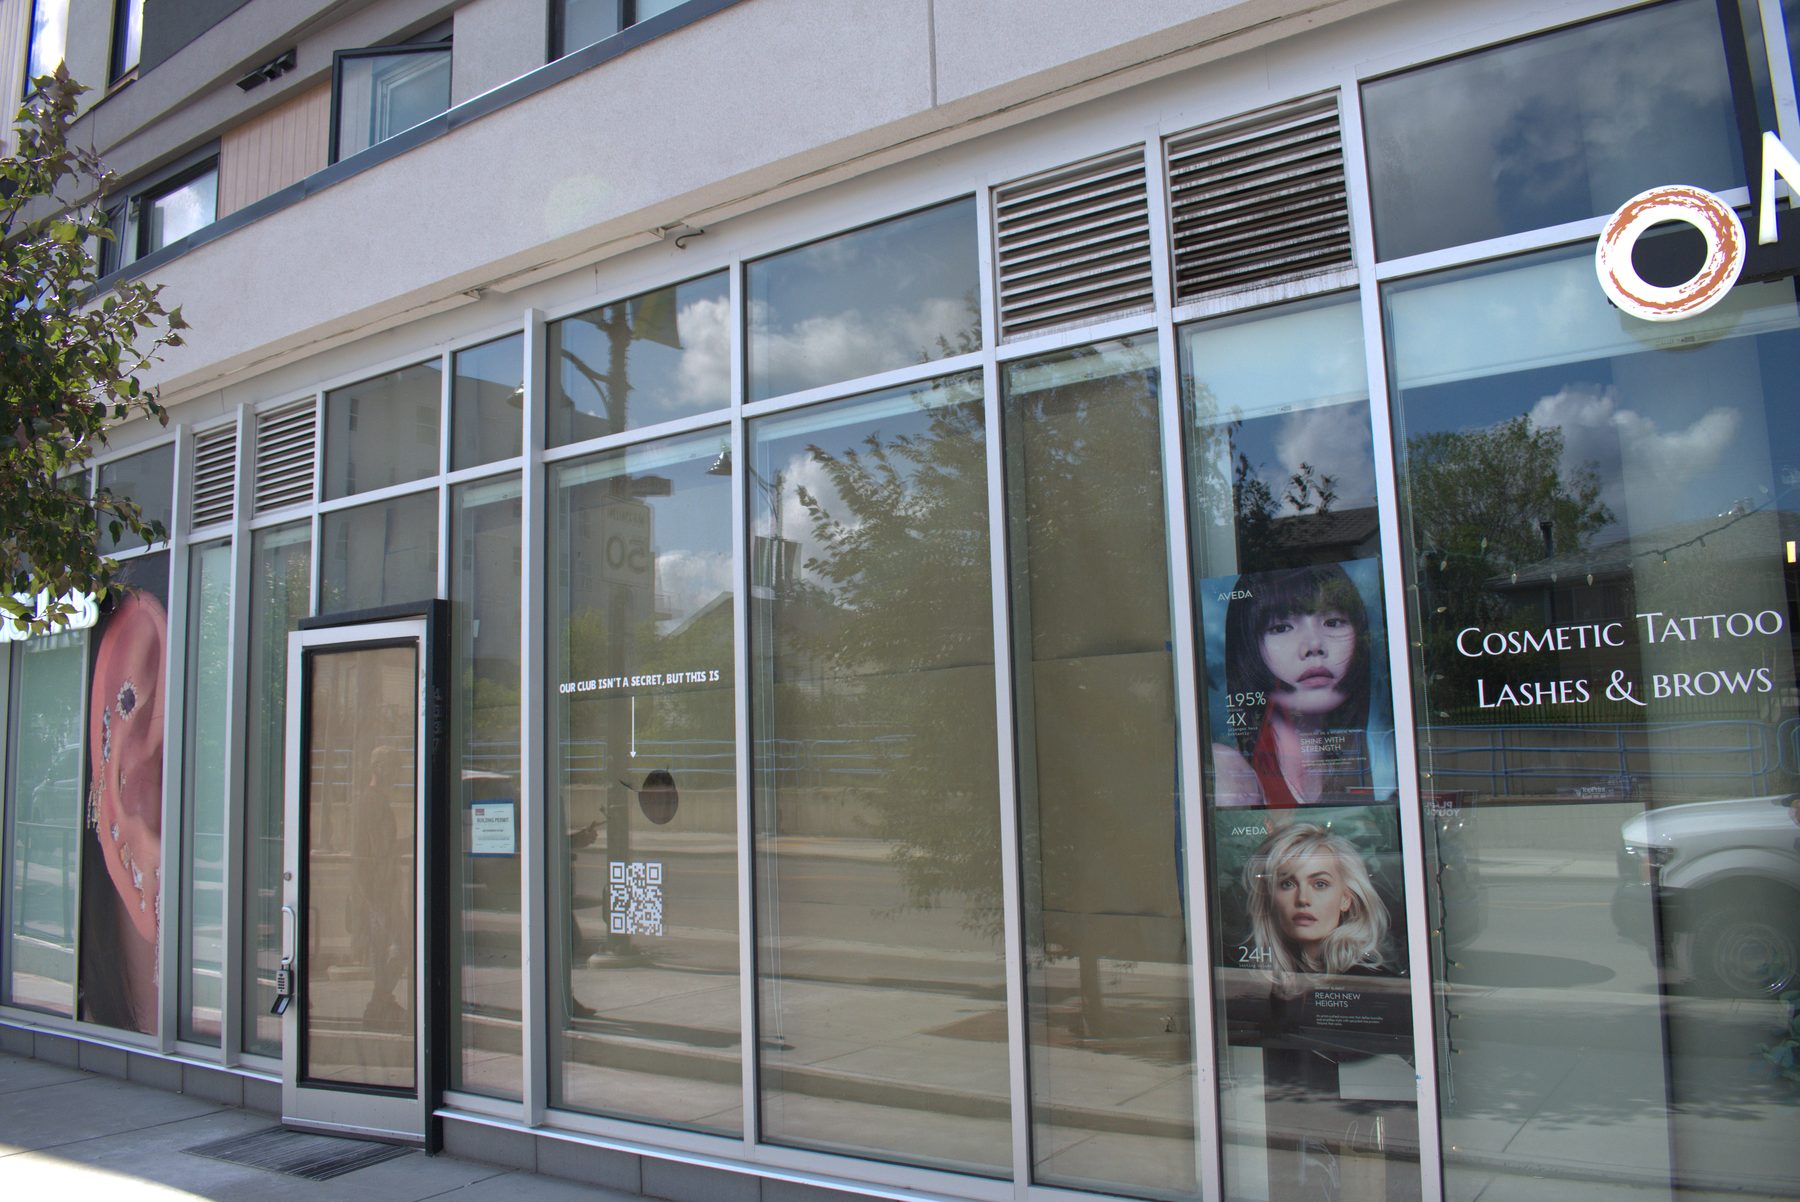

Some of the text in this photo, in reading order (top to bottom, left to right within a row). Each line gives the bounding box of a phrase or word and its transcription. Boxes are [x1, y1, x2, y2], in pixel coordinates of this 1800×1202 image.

[1217, 590, 1253, 601] AVEDA
[559, 670, 720, 694] OUR CLUB ISN'T A SECRET, BUT THIS IS
[1605, 669, 1648, 706] &
[1225, 691, 1267, 707] 195%
[1226, 712, 1247, 726] 4X
[1300, 736, 1346, 746] SHINE WITH
[1301, 744, 1342, 753] STRENGTH
[1231, 826, 1268, 836] AVEDA
[1238, 946, 1272, 962] 24H
[1314, 992, 1341, 1000] REACH
